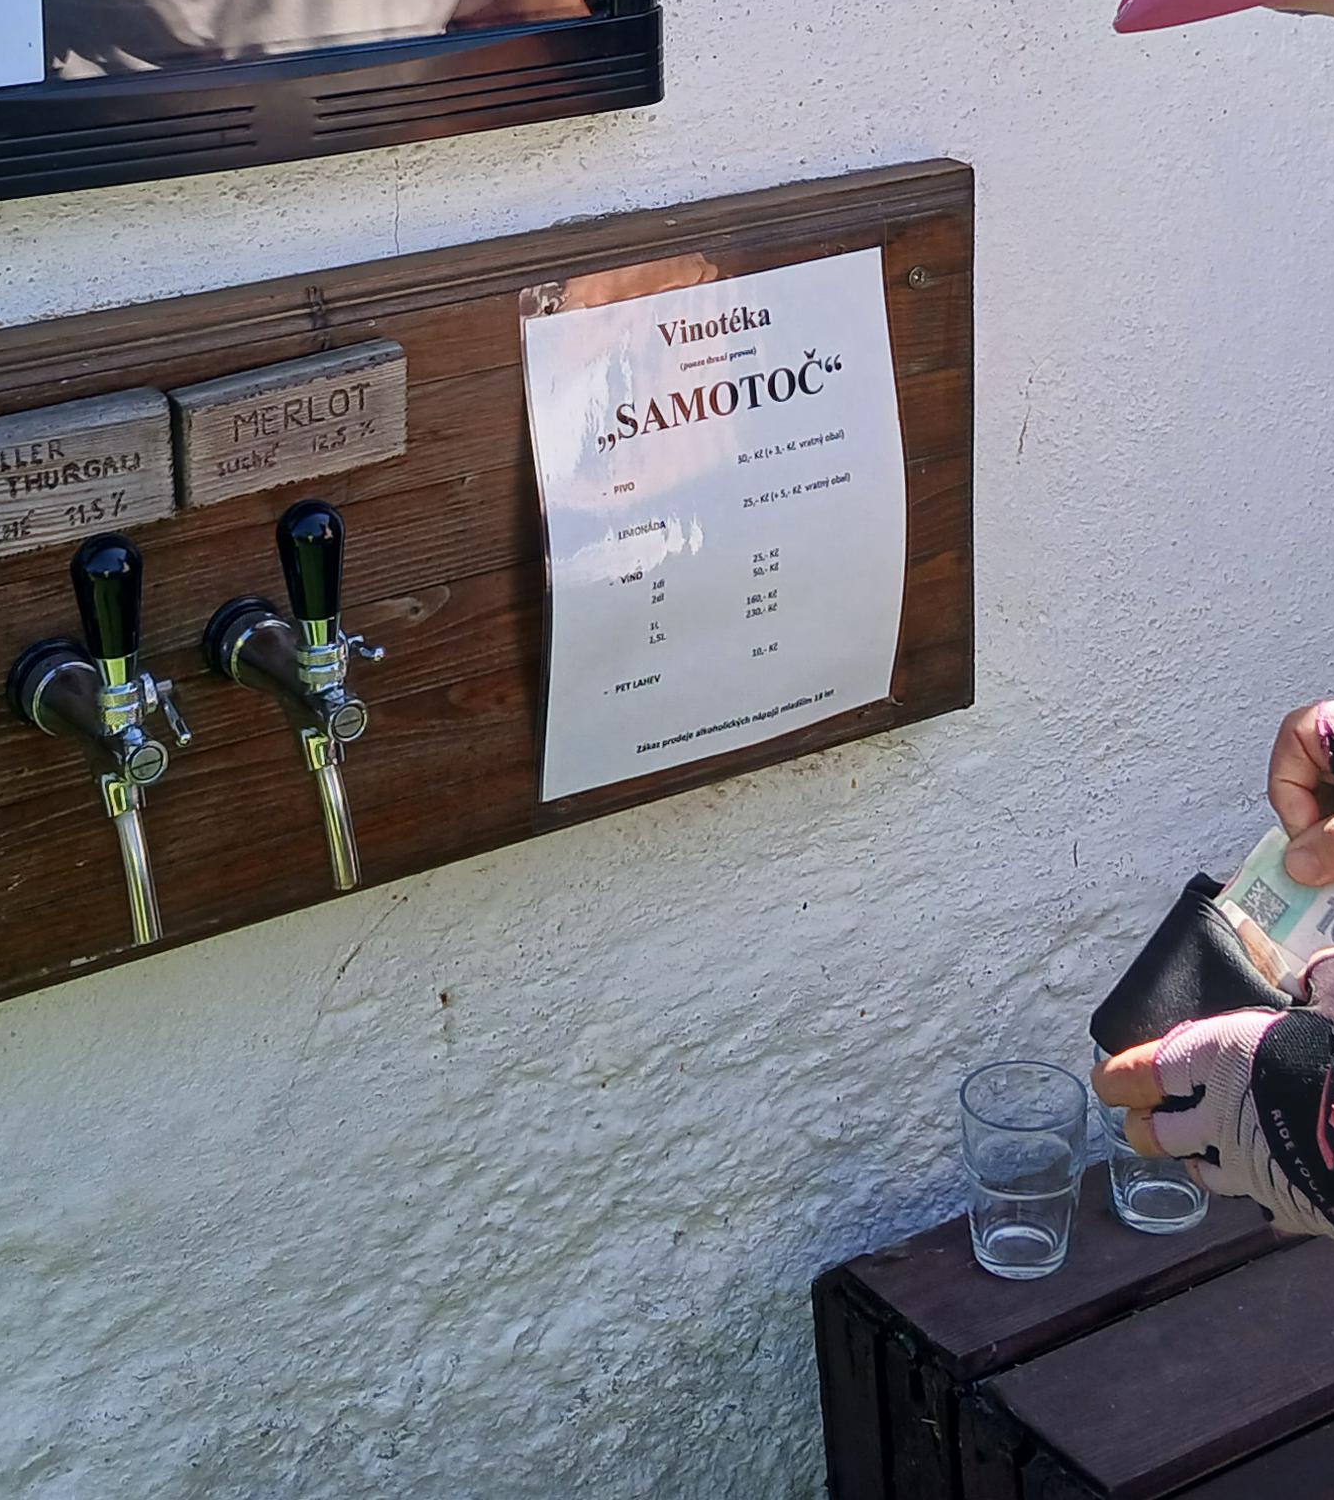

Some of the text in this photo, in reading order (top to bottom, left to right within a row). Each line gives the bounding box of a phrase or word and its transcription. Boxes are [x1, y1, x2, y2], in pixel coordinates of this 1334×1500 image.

[658, 305, 772, 348] Vinotéka
[233, 381, 371, 442] MERLOT
[613, 481, 636, 494] PIVO
[615, 679, 631, 694] PET
[636, 741, 661, 754] Zákaz
[662, 731, 694, 749] prodeje
[695, 716, 751, 739] alkoholických
[1270, 1108, 1295, 1151] RIDE
